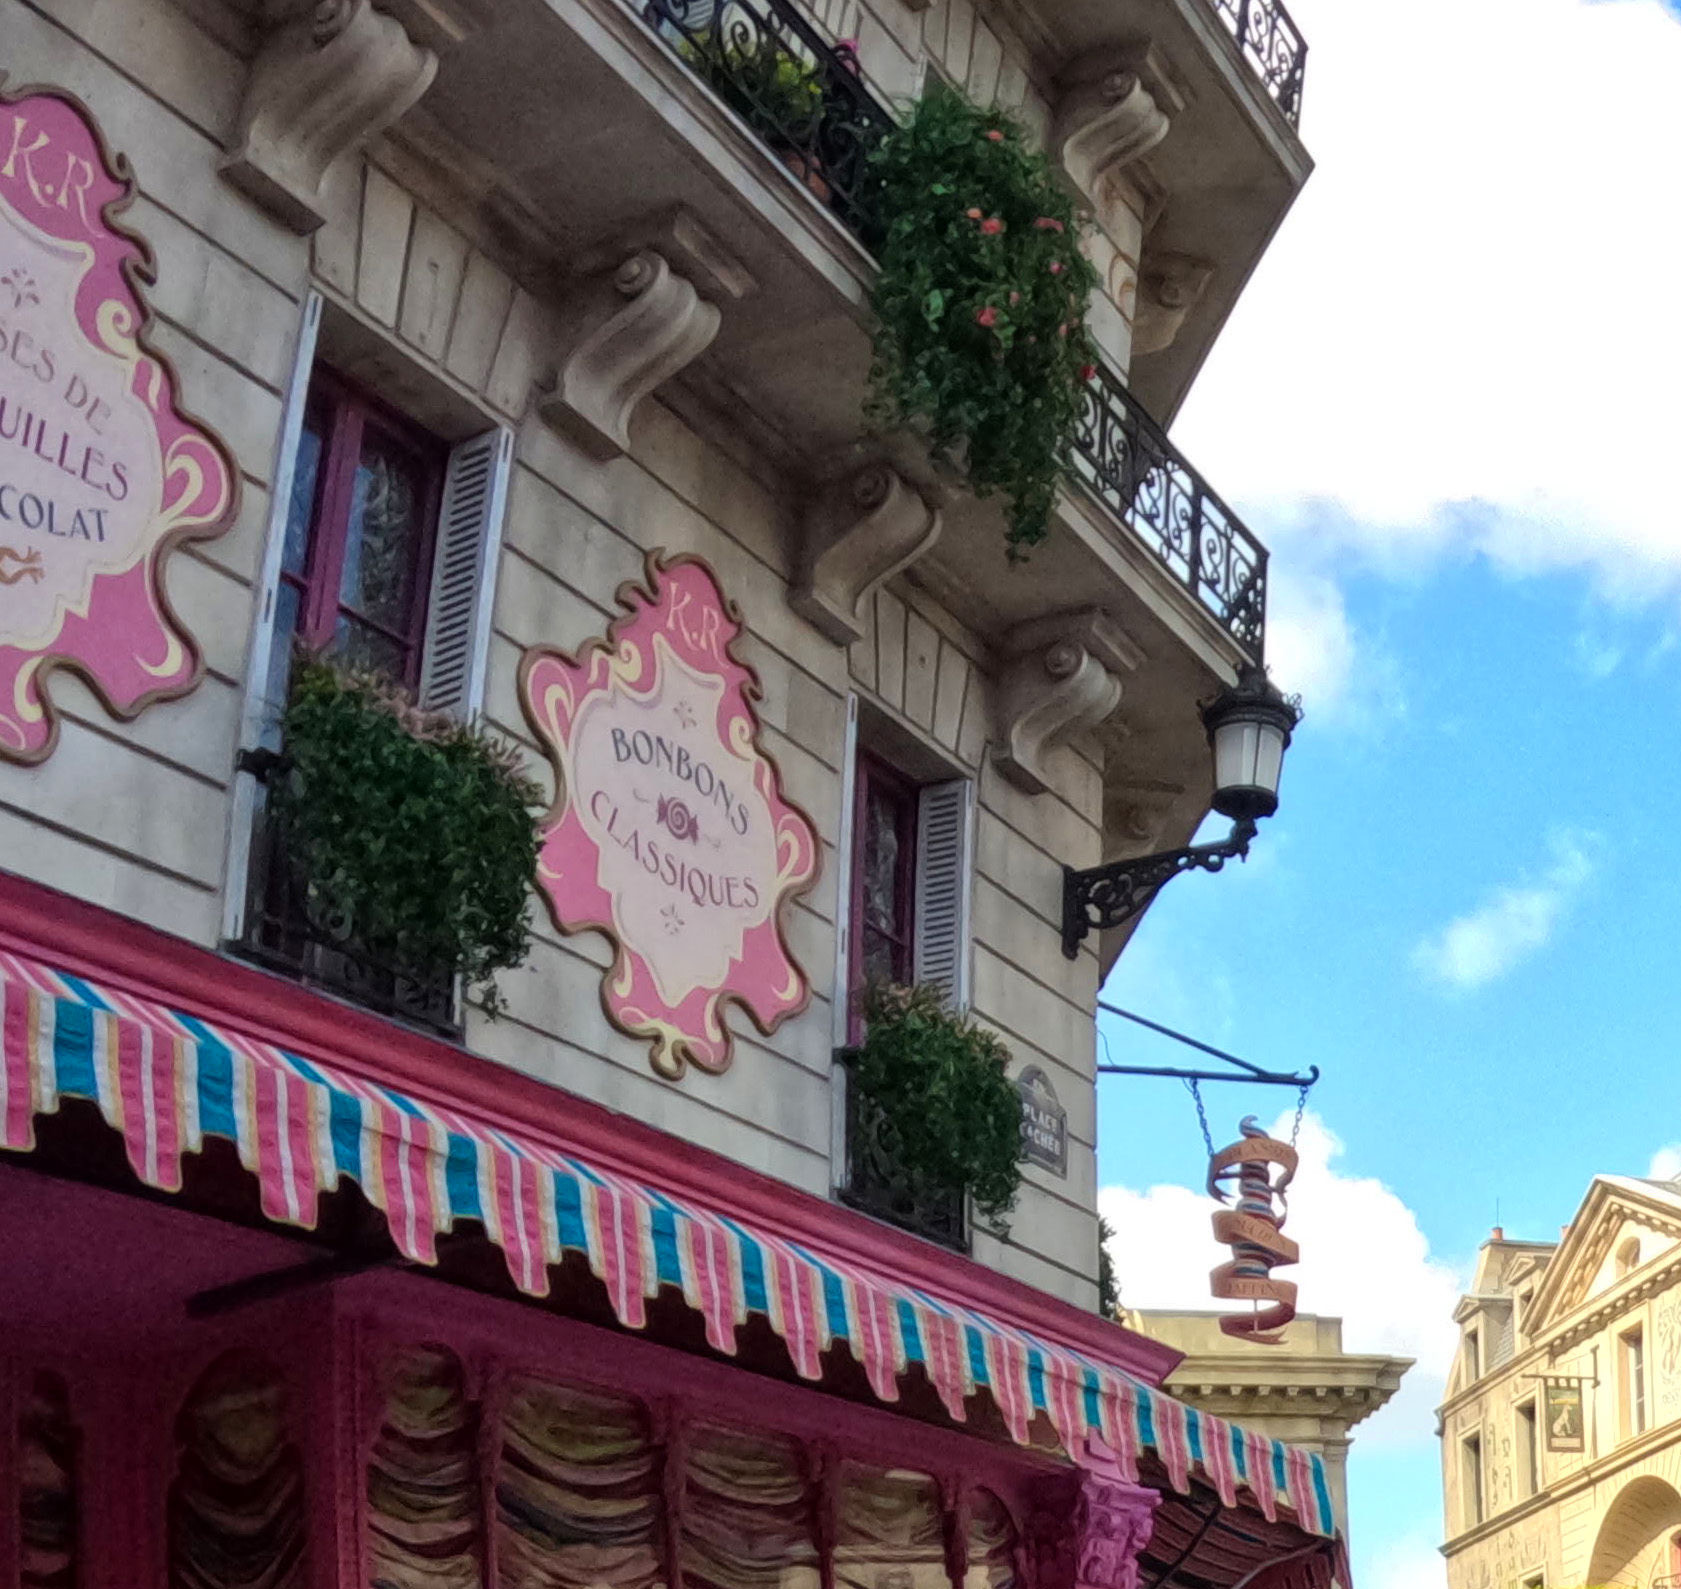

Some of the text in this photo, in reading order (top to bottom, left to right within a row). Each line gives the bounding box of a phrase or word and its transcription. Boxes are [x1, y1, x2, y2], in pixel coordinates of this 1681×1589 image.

[64, 373, 112, 436] DE
[611, 727, 748, 836] BONBONS
[591, 789, 759, 908] CLASSIQUES
